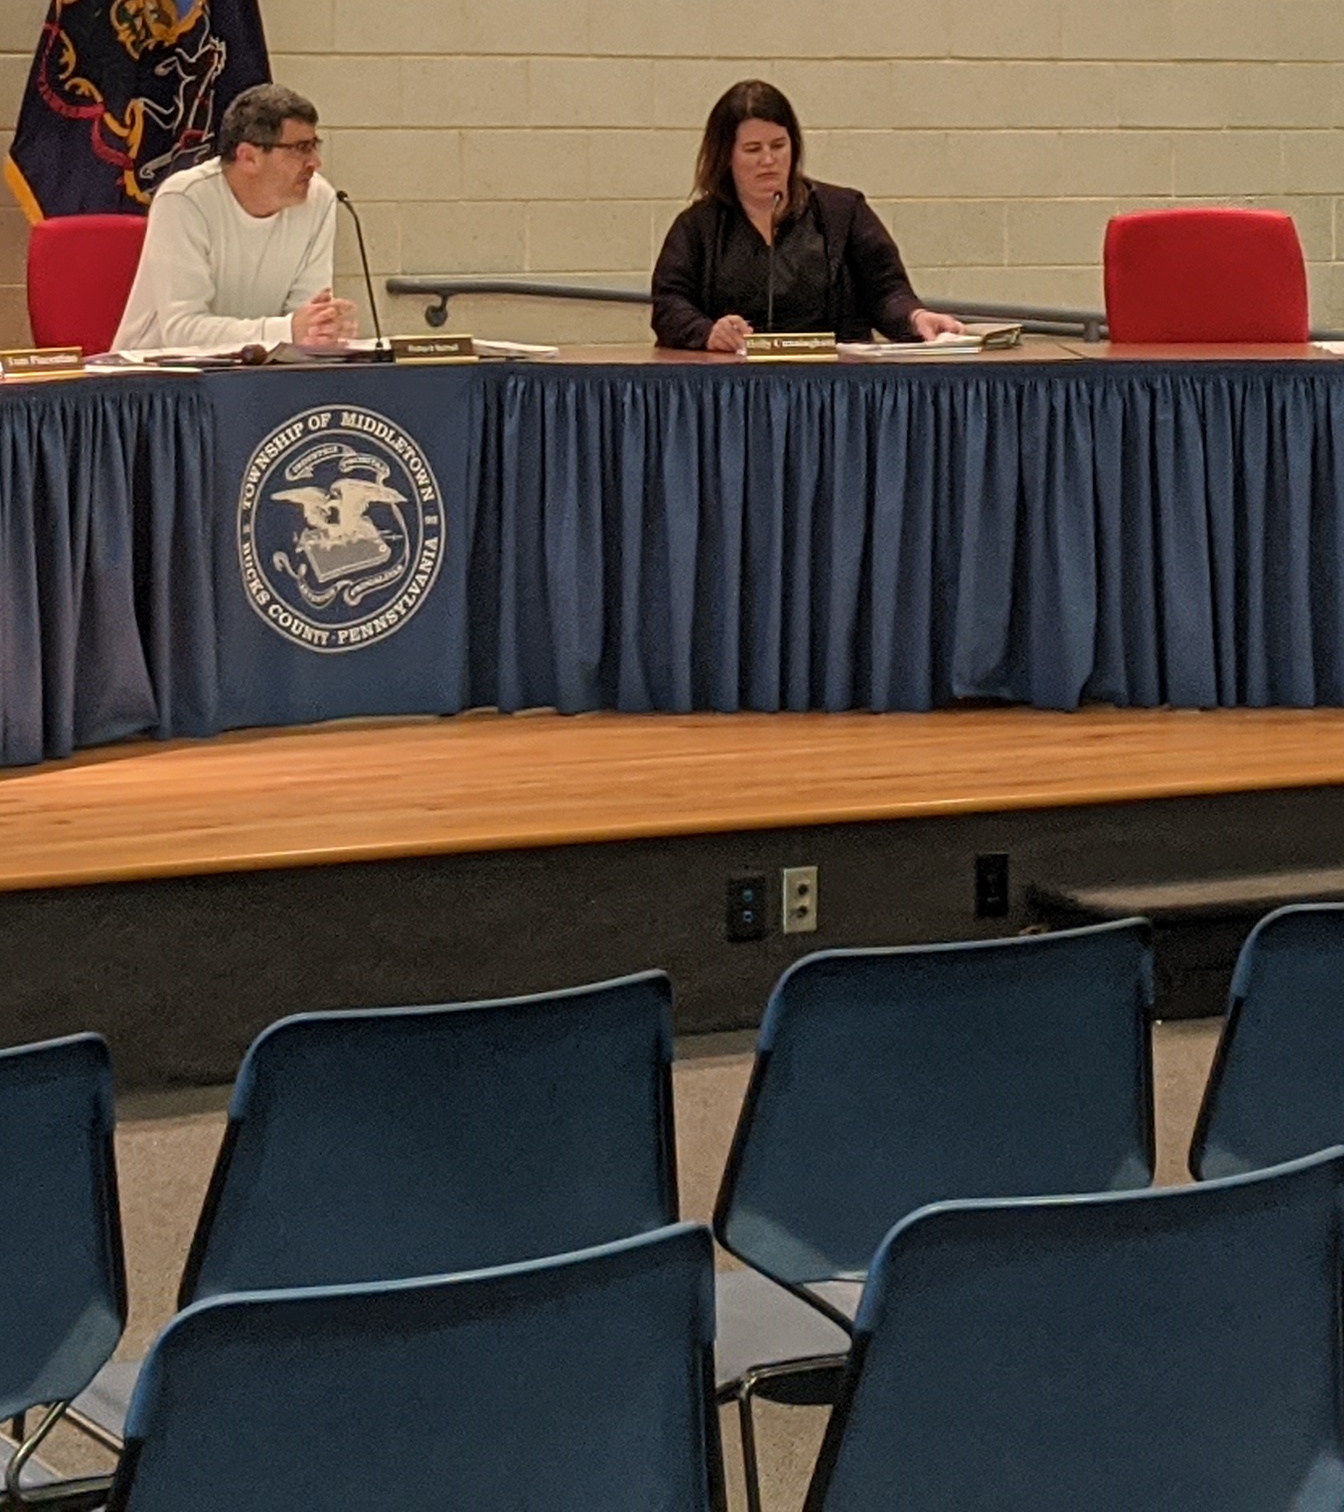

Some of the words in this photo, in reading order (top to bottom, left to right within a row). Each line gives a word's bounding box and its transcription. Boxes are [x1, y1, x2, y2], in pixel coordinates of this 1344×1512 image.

[242, 422, 304, 510] TOWNSHIP
[308, 412, 332, 430] OF
[340, 411, 435, 502] MIDDLETOWN
[243, 542, 270, 605] BUCKS
[268, 604, 330, 645] COUNTY
[338, 537, 438, 645] PENNSYLVANIA
